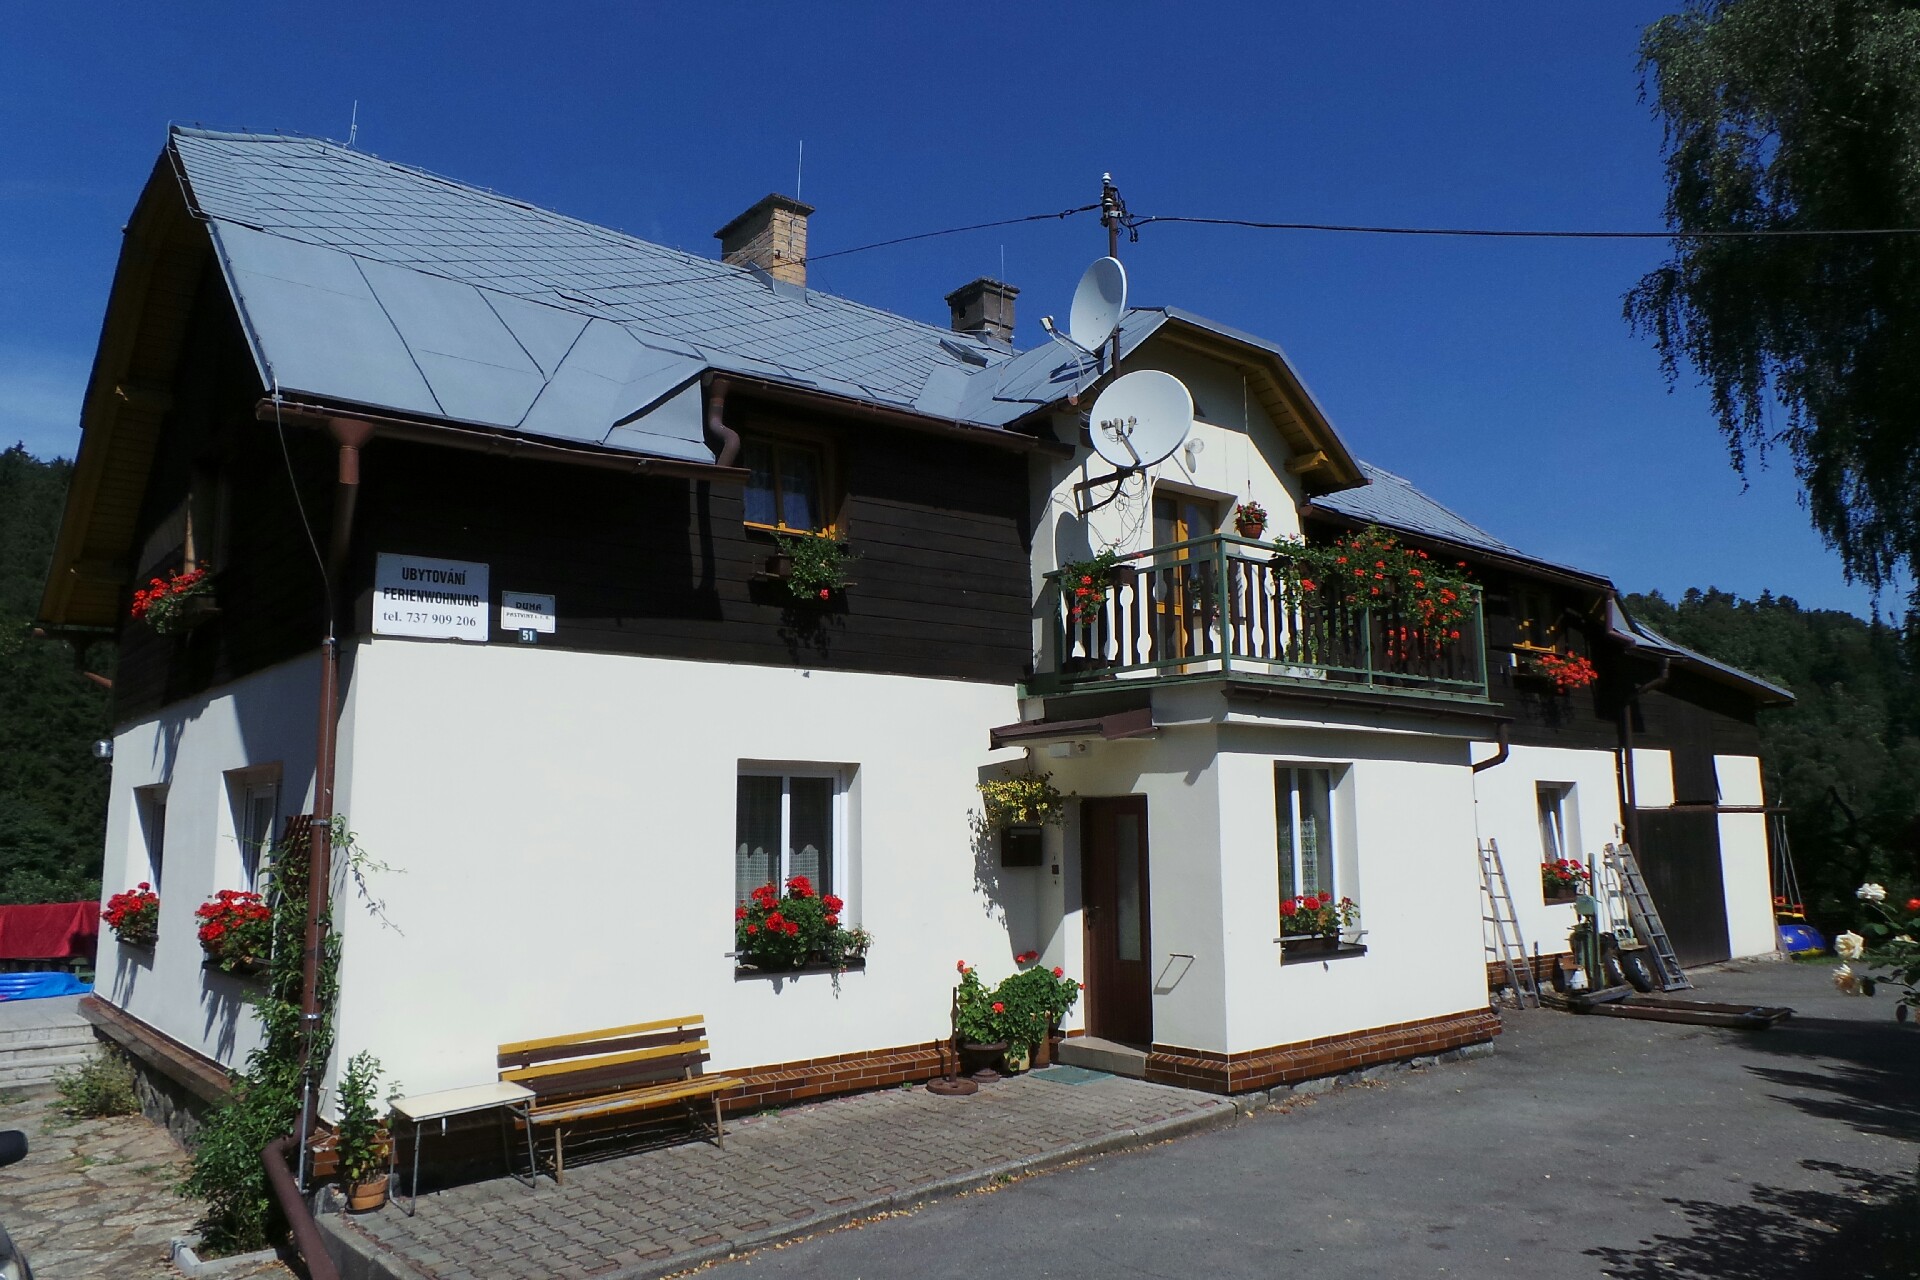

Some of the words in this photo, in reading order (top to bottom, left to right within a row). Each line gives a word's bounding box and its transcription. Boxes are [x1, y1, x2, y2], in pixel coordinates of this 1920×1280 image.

[402, 567, 467, 585] UBYTOVÁNÍ
[383, 587, 479, 607] FERIENWOHNUNG
[515, 601, 542, 611] DUHA
[383, 611, 402, 622] tel.
[406, 612, 428, 624] 737
[432, 614, 452, 625] 909
[456, 615, 476, 627] 206
[522, 630, 533, 641] 51
